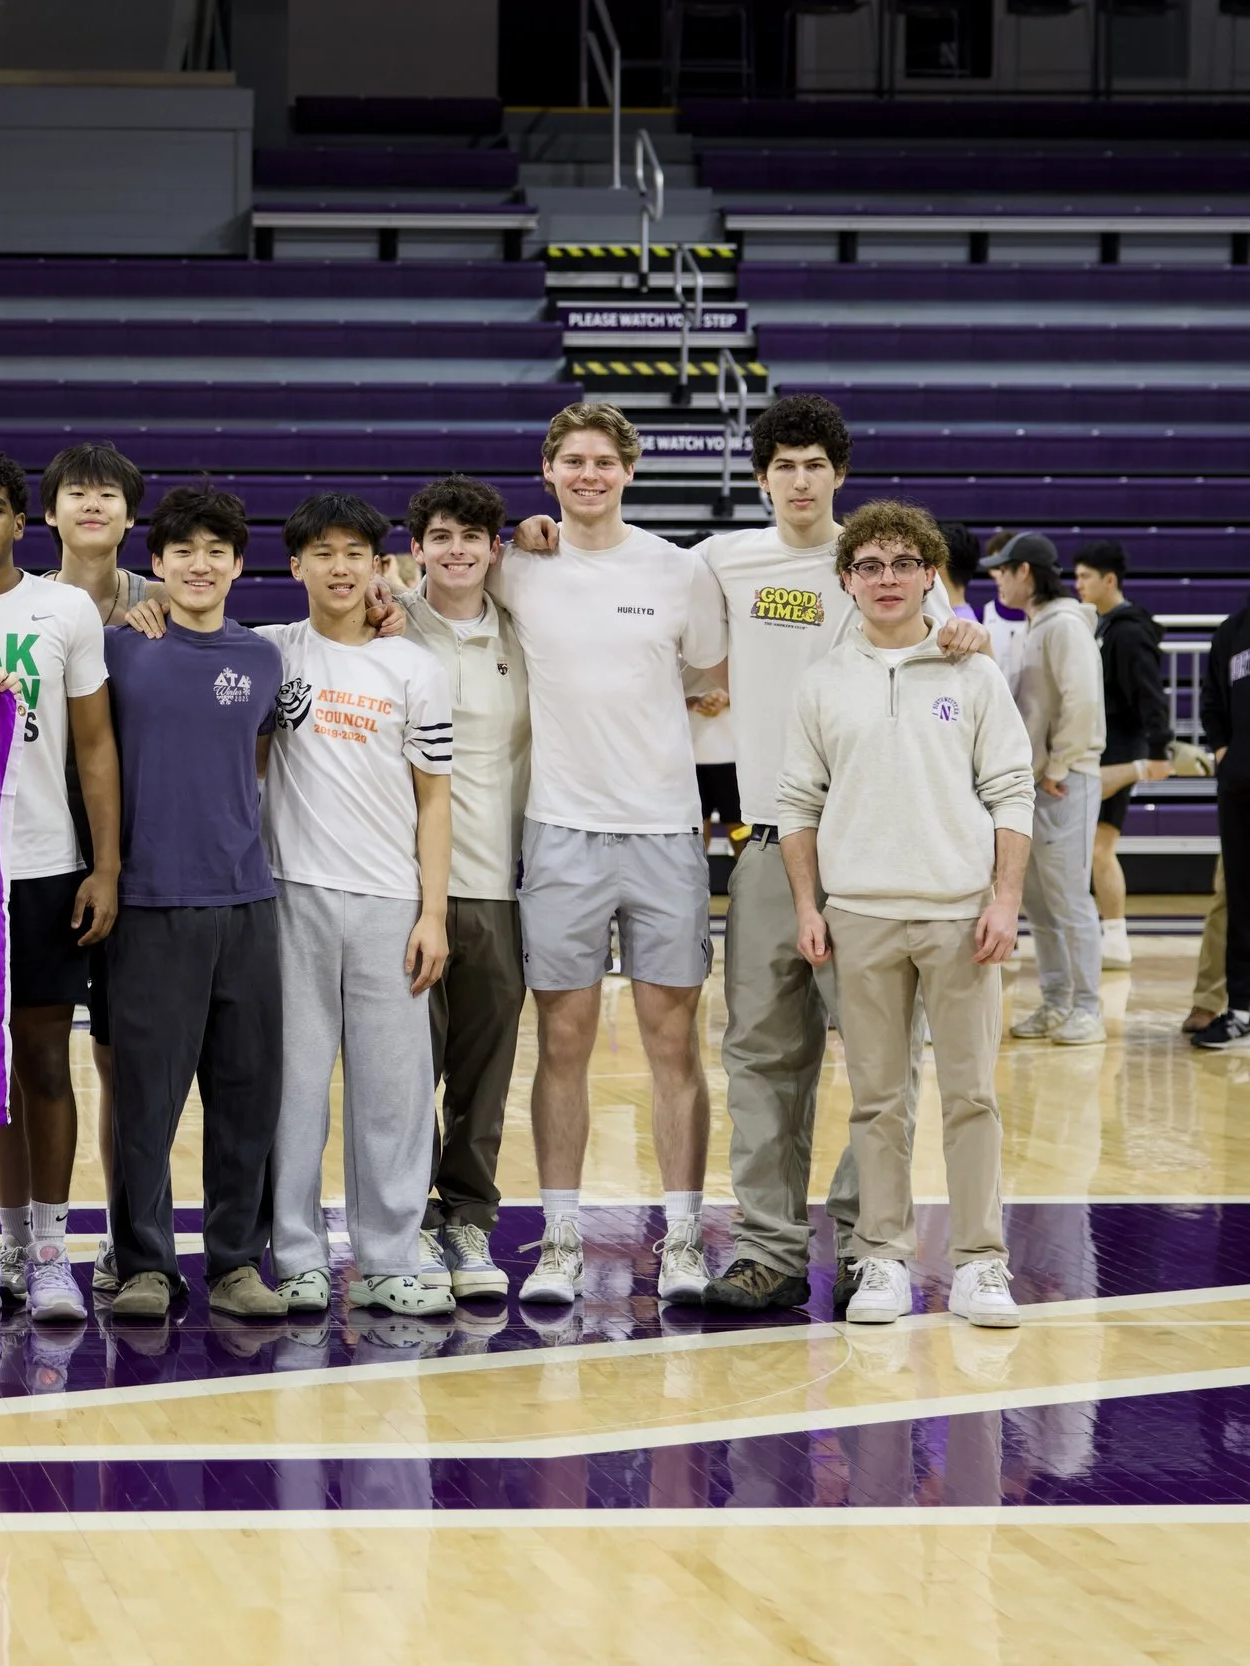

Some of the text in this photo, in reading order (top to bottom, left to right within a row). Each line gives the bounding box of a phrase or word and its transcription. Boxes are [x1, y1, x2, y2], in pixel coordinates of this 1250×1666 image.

[568, 312, 618, 328] PLEASE
[619, 312, 666, 328] WATCH
[704, 312, 738, 328] STEP
[656, 435, 705, 451] WATCH
[759, 586, 818, 608] GOOD
[617, 606, 646, 615] HURLEY
[755, 601, 819, 623] TIMES
[213, 685, 243, 696] Winter
[234, 695, 250, 703] 2025
[317, 688, 393, 716] ATHLETIC
[314, 708, 379, 733] COUNCIL
[940, 704, 951, 721] N
[313, 724, 368, 744] 2019-2020
